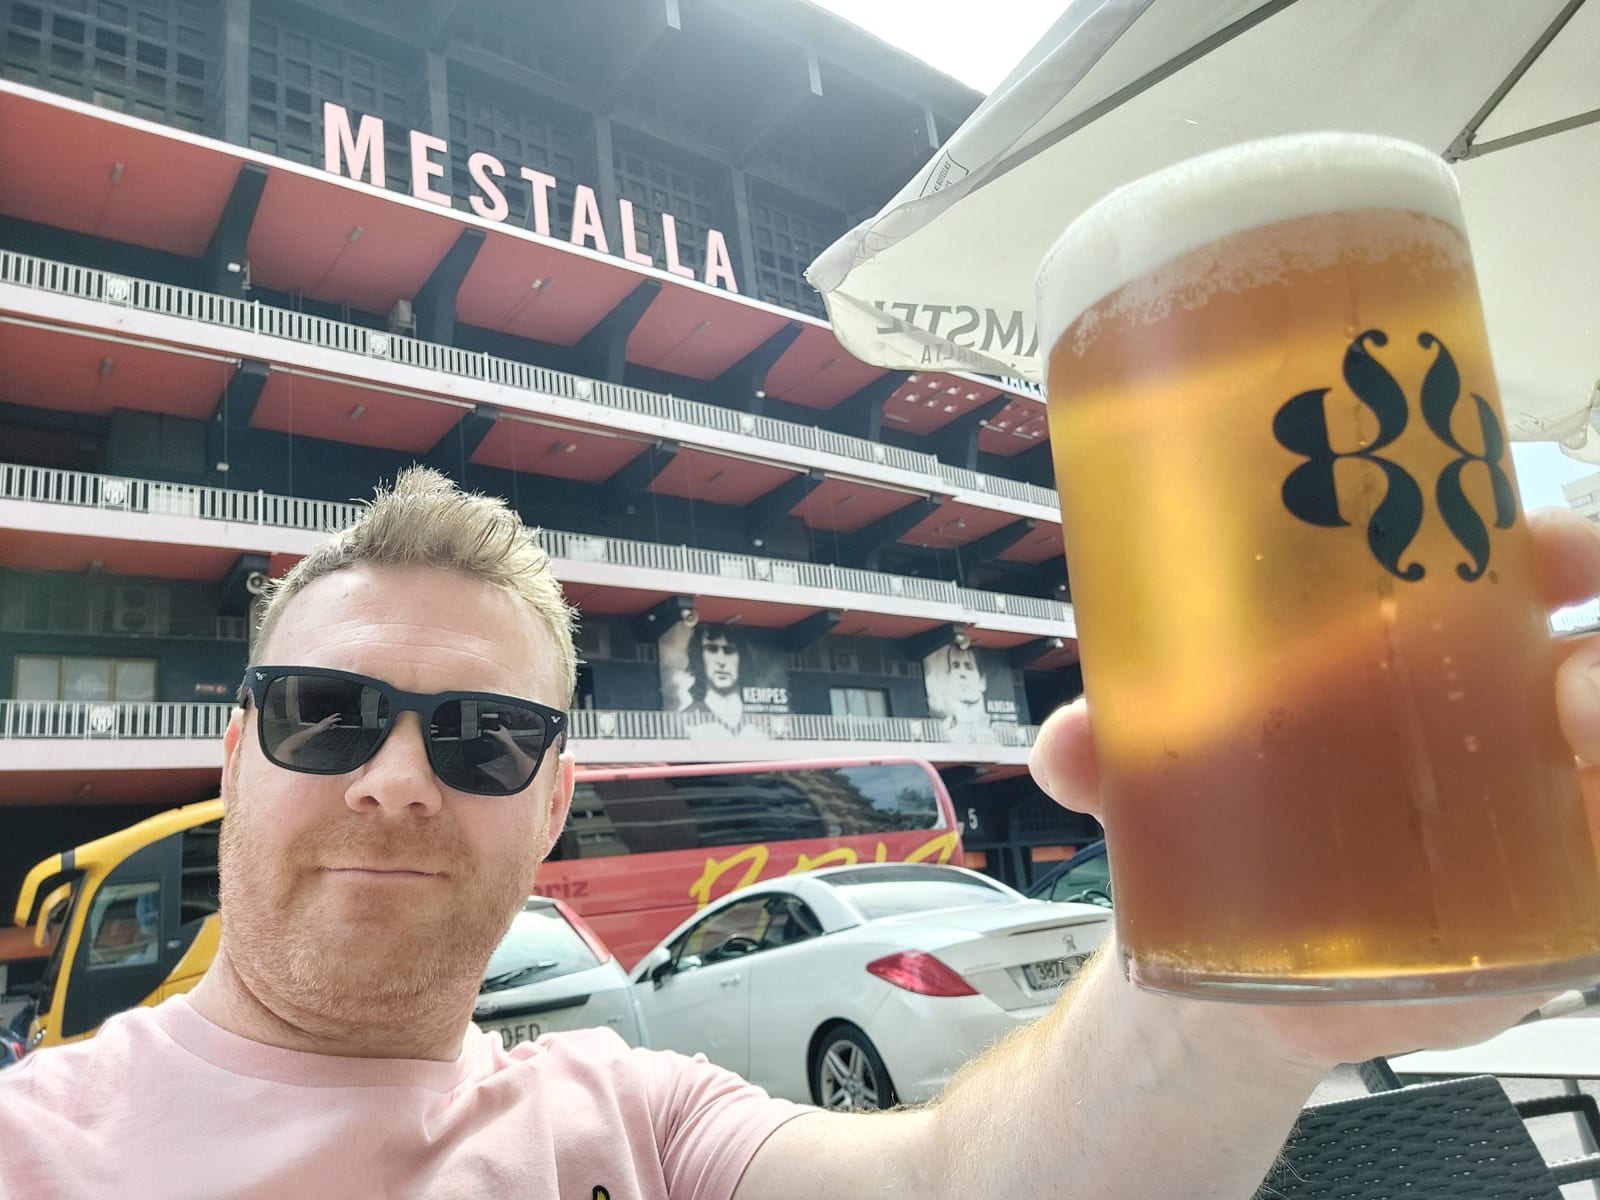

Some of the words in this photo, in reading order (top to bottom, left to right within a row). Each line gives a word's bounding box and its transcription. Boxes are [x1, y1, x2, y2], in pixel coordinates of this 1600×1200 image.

[323, 101, 739, 293] MESTALLA
[742, 686, 788, 704] KEMPES
[968, 808, 978, 830] 5
